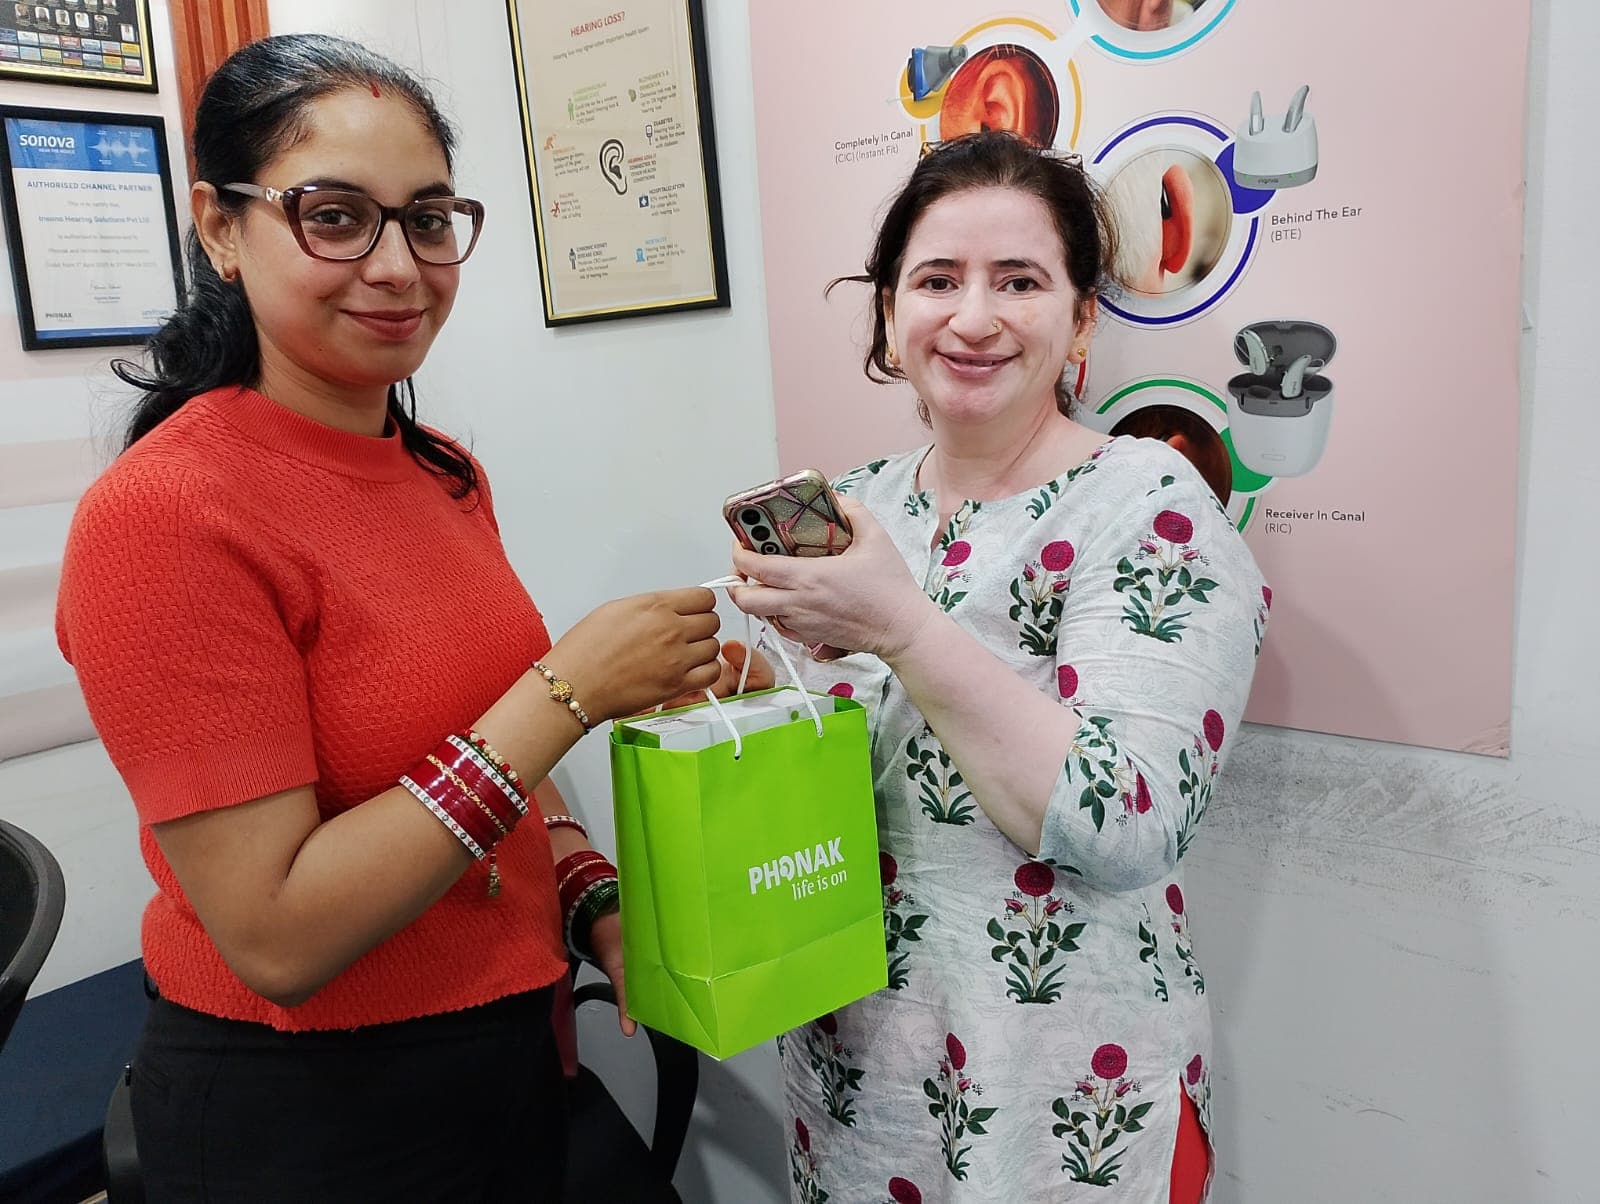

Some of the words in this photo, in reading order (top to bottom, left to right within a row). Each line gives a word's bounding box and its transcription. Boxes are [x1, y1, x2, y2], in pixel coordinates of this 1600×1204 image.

[570, 19, 603, 37] HEARING
[604, 11, 626, 26] LOSS?
[653, 117, 673, 127] DIABETES
[19, 133, 75, 149] sonova
[834, 135, 880, 151] Completely
[881, 133, 889, 142] In
[890, 128, 914, 140] Canal
[886, 144, 899, 154] Fit)
[27, 180, 79, 190] AUTHORISED
[80, 183, 117, 192] CHANNEL
[118, 184, 153, 193] PARTNER
[1271, 210, 1313, 226] Behind
[1316, 208, 1338, 220] The
[1342, 205, 1363, 218] Ear
[1270, 227, 1302, 243] (BTE)
[1265, 508, 1314, 521] Receiver
[1317, 509, 1328, 521] In
[1331, 510, 1365, 522] Canal
[1264, 523, 1292, 535] (RIC)
[748, 836, 845, 895] PHONAK
[792, 879, 815, 901] life
[817, 875, 829, 891] is
[831, 870, 847, 886] on
